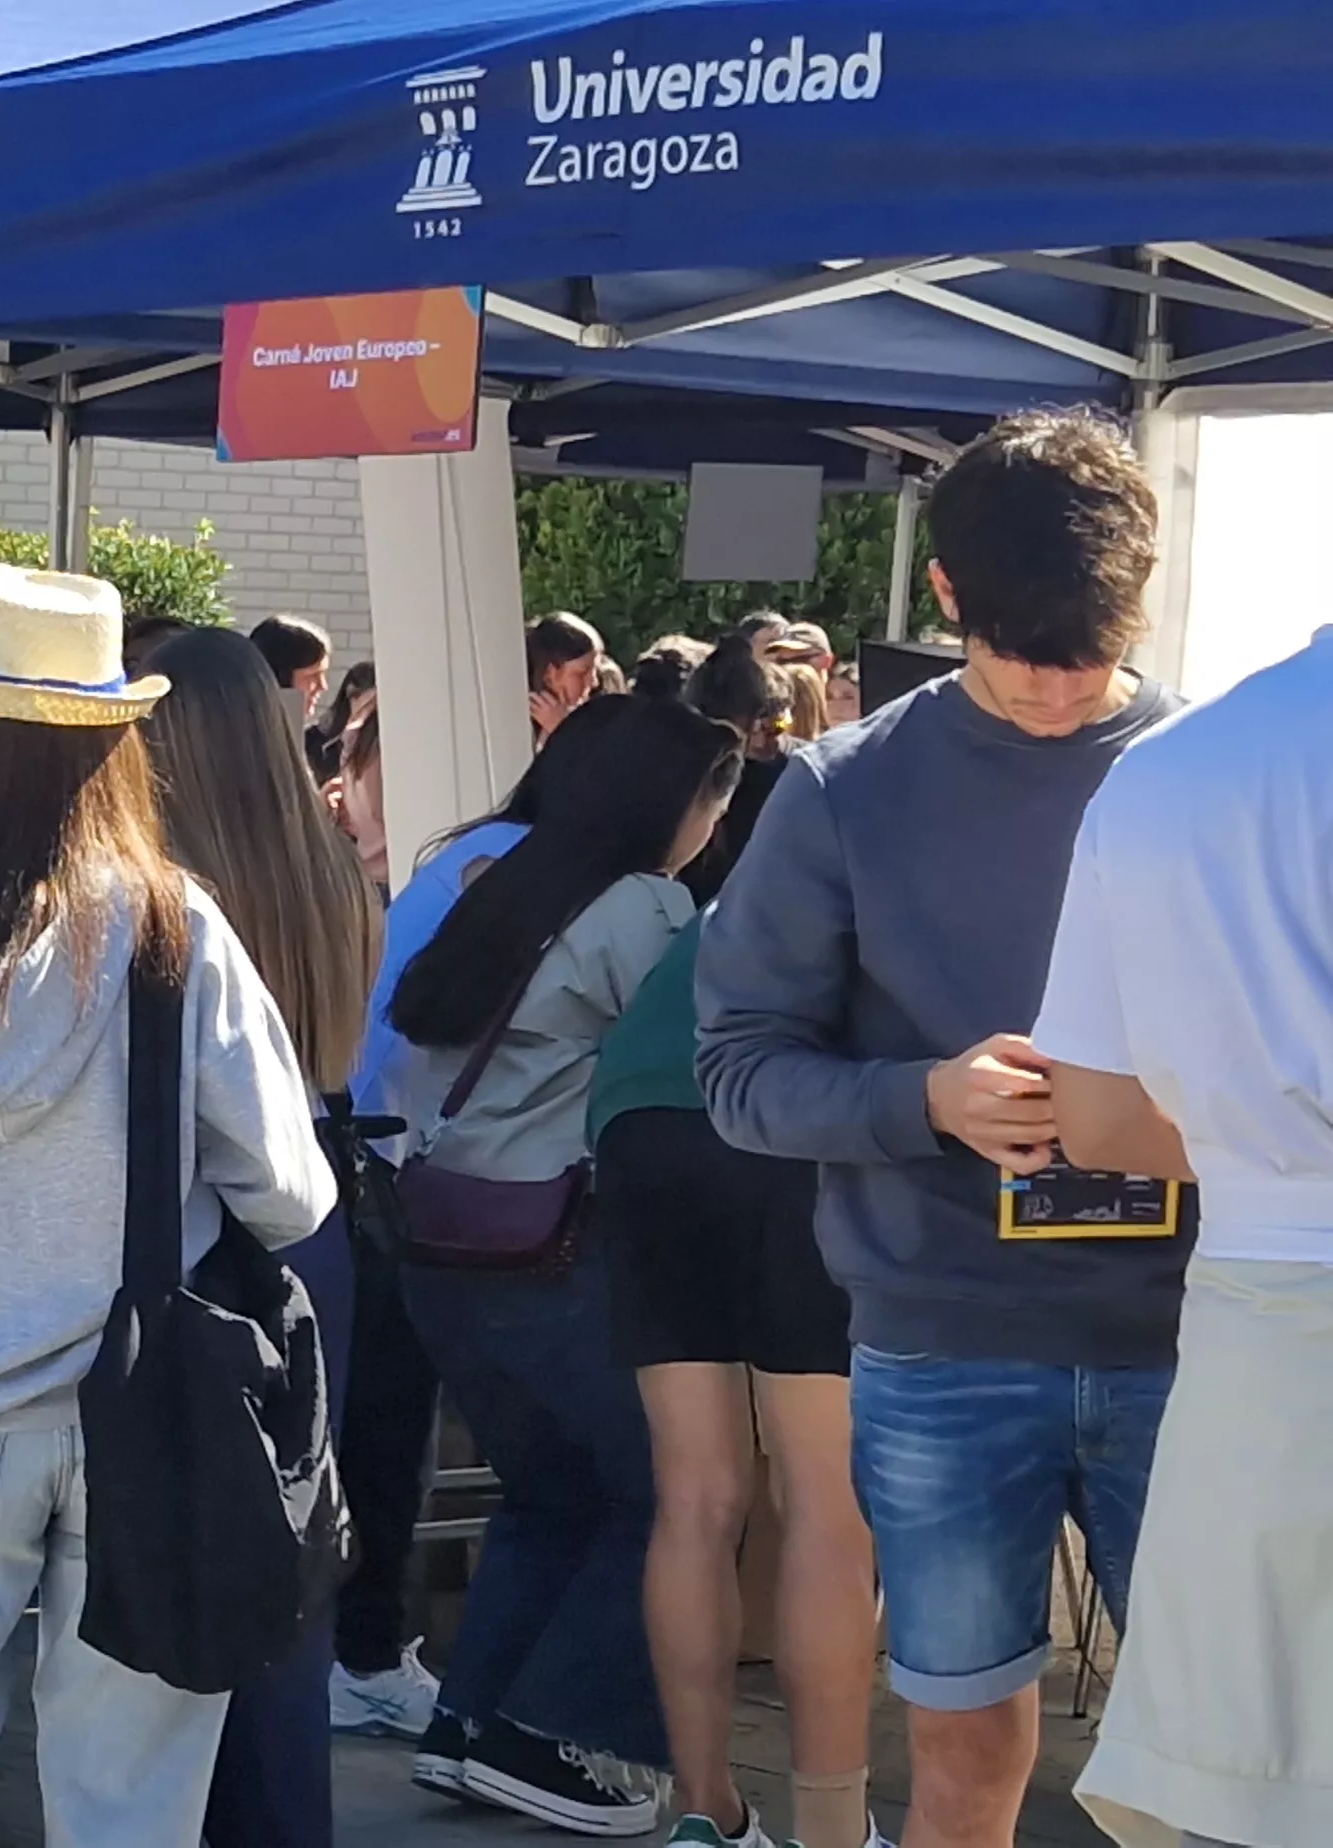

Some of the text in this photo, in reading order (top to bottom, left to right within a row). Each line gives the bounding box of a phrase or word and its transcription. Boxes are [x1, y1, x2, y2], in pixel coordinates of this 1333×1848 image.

[531, 31, 882, 124] Universidad
[524, 131, 739, 190] Zaragoza
[413, 218, 462, 239] 1542
[253, 341, 301, 367] Carné
[303, 343, 353, 364] Joven
[357, 338, 426, 363] Europeo
[329, 368, 358, 389] IAJ
